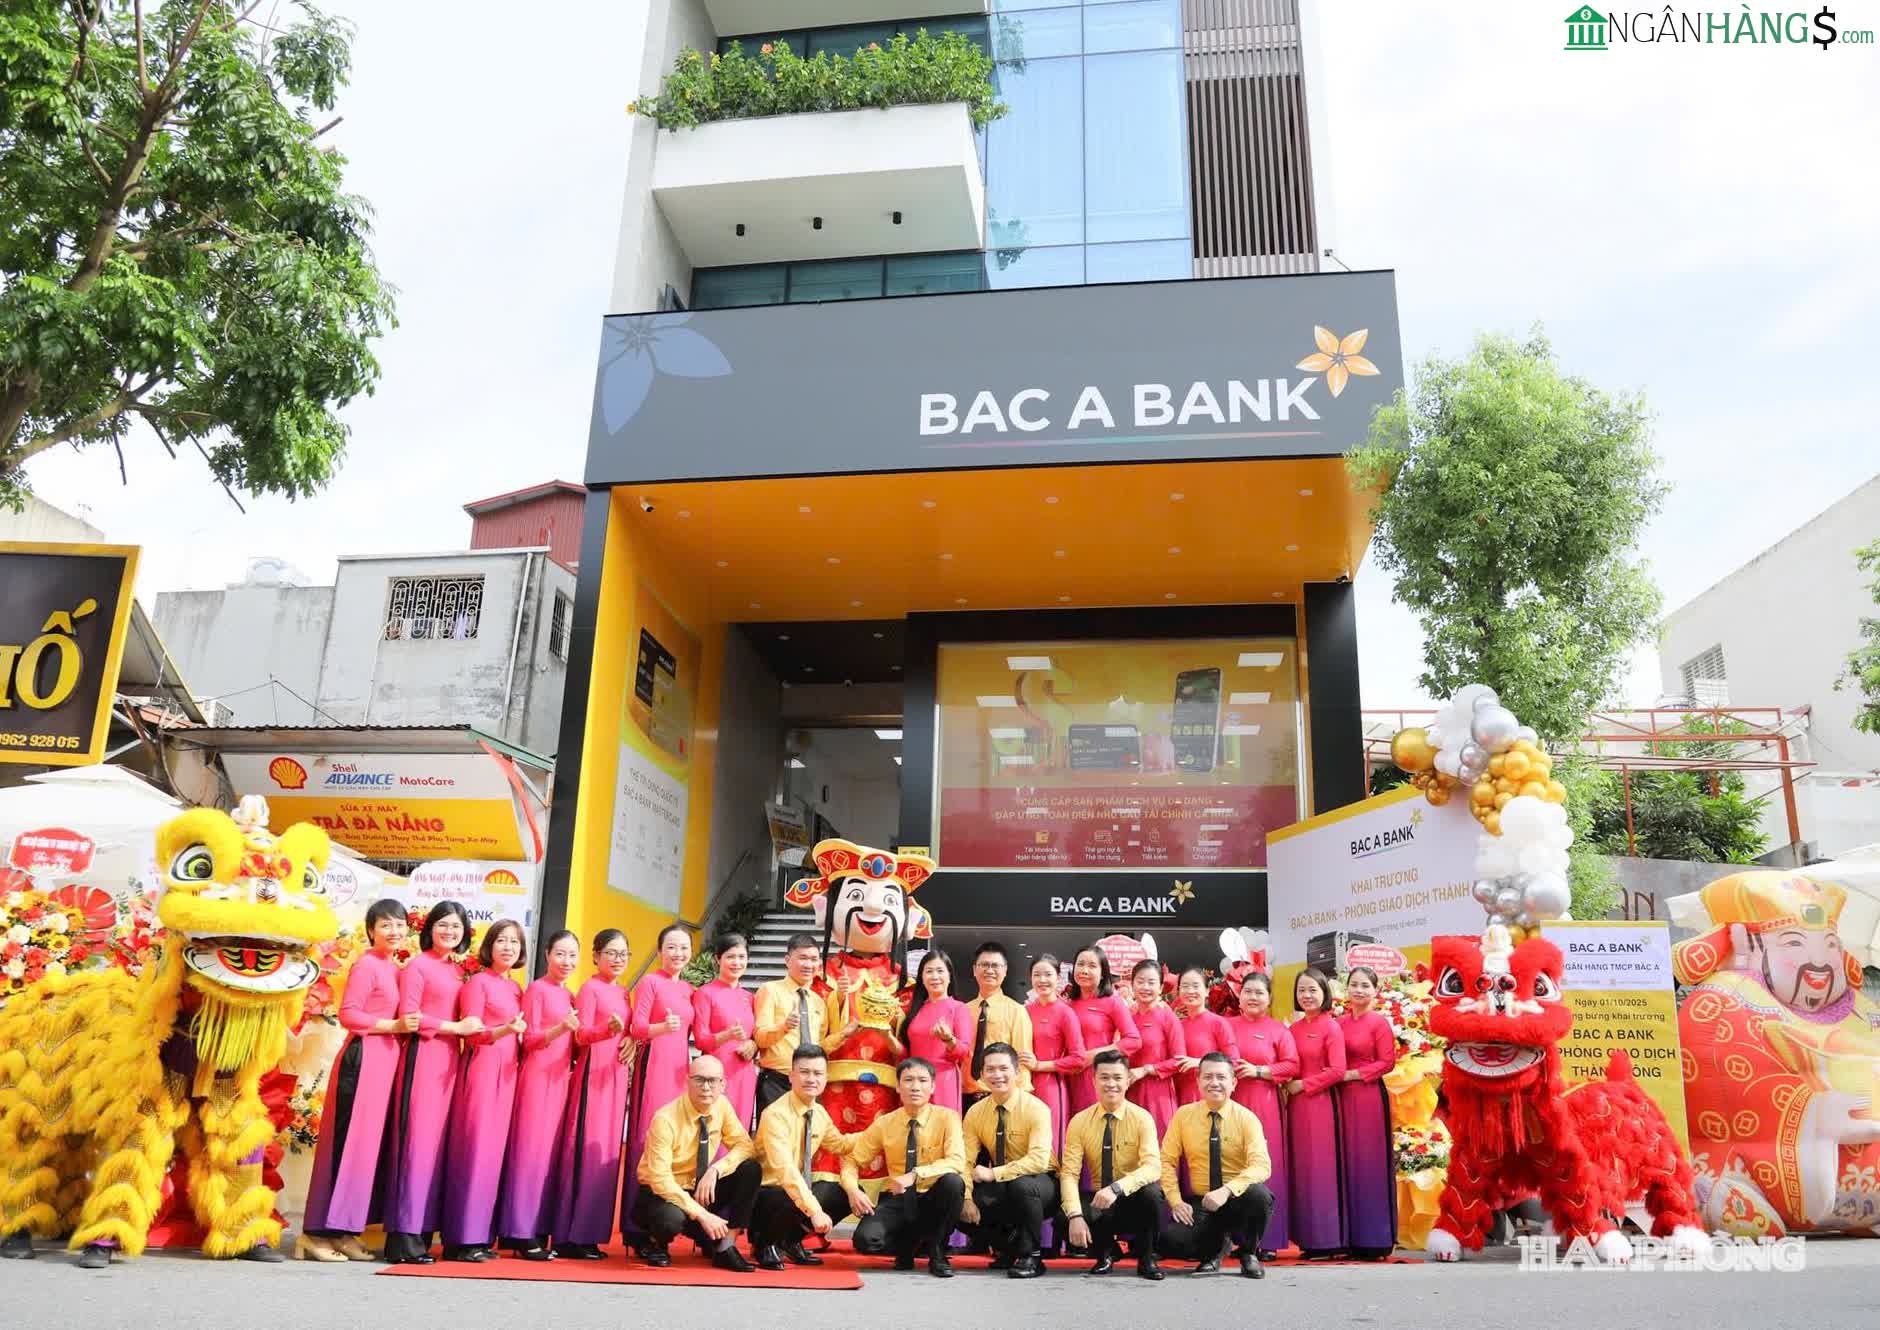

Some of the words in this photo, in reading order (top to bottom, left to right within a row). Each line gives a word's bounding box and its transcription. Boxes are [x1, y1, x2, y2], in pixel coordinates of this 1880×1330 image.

[919, 387, 1052, 435] BAC
[1066, 385, 1116, 430] A
[1132, 376, 1322, 427] BANK
[0, 733, 27, 747] 962
[29, 735, 56, 748] 928
[56, 736, 81, 749] 015
[332, 763, 358, 773] Shell
[324, 773, 396, 786] ADVANCE
[400, 776, 455, 787] MotoCare
[1350, 836, 1372, 855] BAC
[1373, 834, 1382, 849] A
[1383, 824, 1415, 846] BANK
[1350, 878, 1373, 896] KHAI
[1050, 896, 1094, 914] BAC
[1097, 897, 1113, 913] A
[1117, 896, 1177, 913] BANK
[1314, 909, 1338, 925] BANK
[1378, 895, 1403, 913] GIAO
[465, 909, 495, 921] ANK
[1569, 943, 1595, 953] BAC
[1597, 943, 1607, 953] A
[1609, 943, 1644, 953] BANK
[1562, 962, 1583, 971] GÂN
[1610, 963, 1632, 971] TMCP
[1599, 998, 1648, 1008] 01/10/2025
[1612, 1011, 1631, 1020] khai
[1573, 1028, 1601, 1040] BAC
[1604, 1029, 1614, 1040] A
[1617, 1029, 1655, 1040] BANK
[1606, 1048, 1640, 1059] GO
[1644, 1048, 1676, 1062] DỊCH
[1571, 1063, 1608, 1078] THÀN
